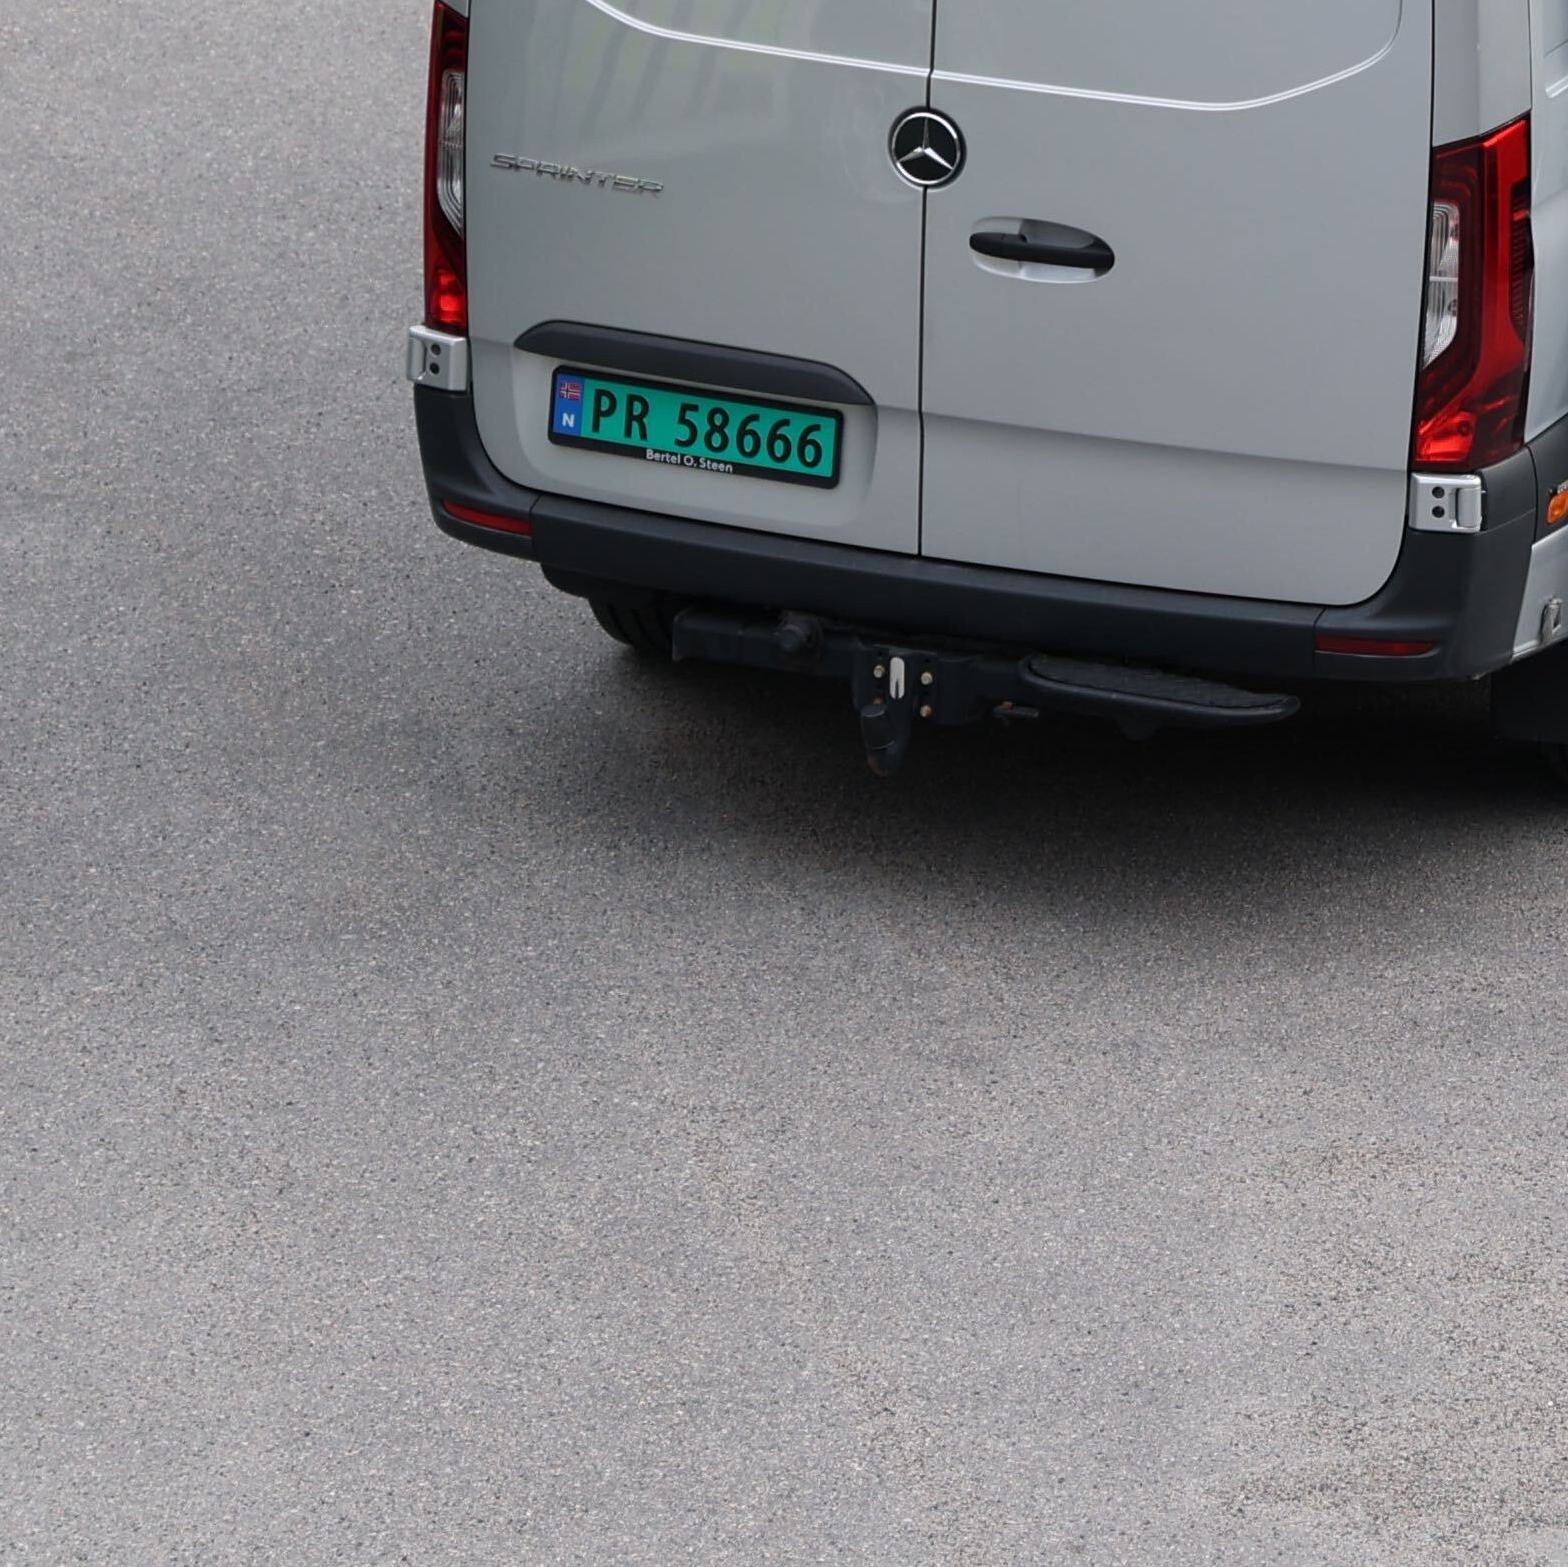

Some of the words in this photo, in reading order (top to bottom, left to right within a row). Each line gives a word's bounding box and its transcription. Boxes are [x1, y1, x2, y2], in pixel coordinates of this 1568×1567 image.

[490, 152, 665, 197] SPRINTER
[561, 412, 575, 429] N
[592, 388, 650, 442] PR
[674, 403, 823, 469] 58666
[646, 448, 681, 465] Bertel
[683, 454, 698, 468] O.
[699, 457, 733, 473] Steen
